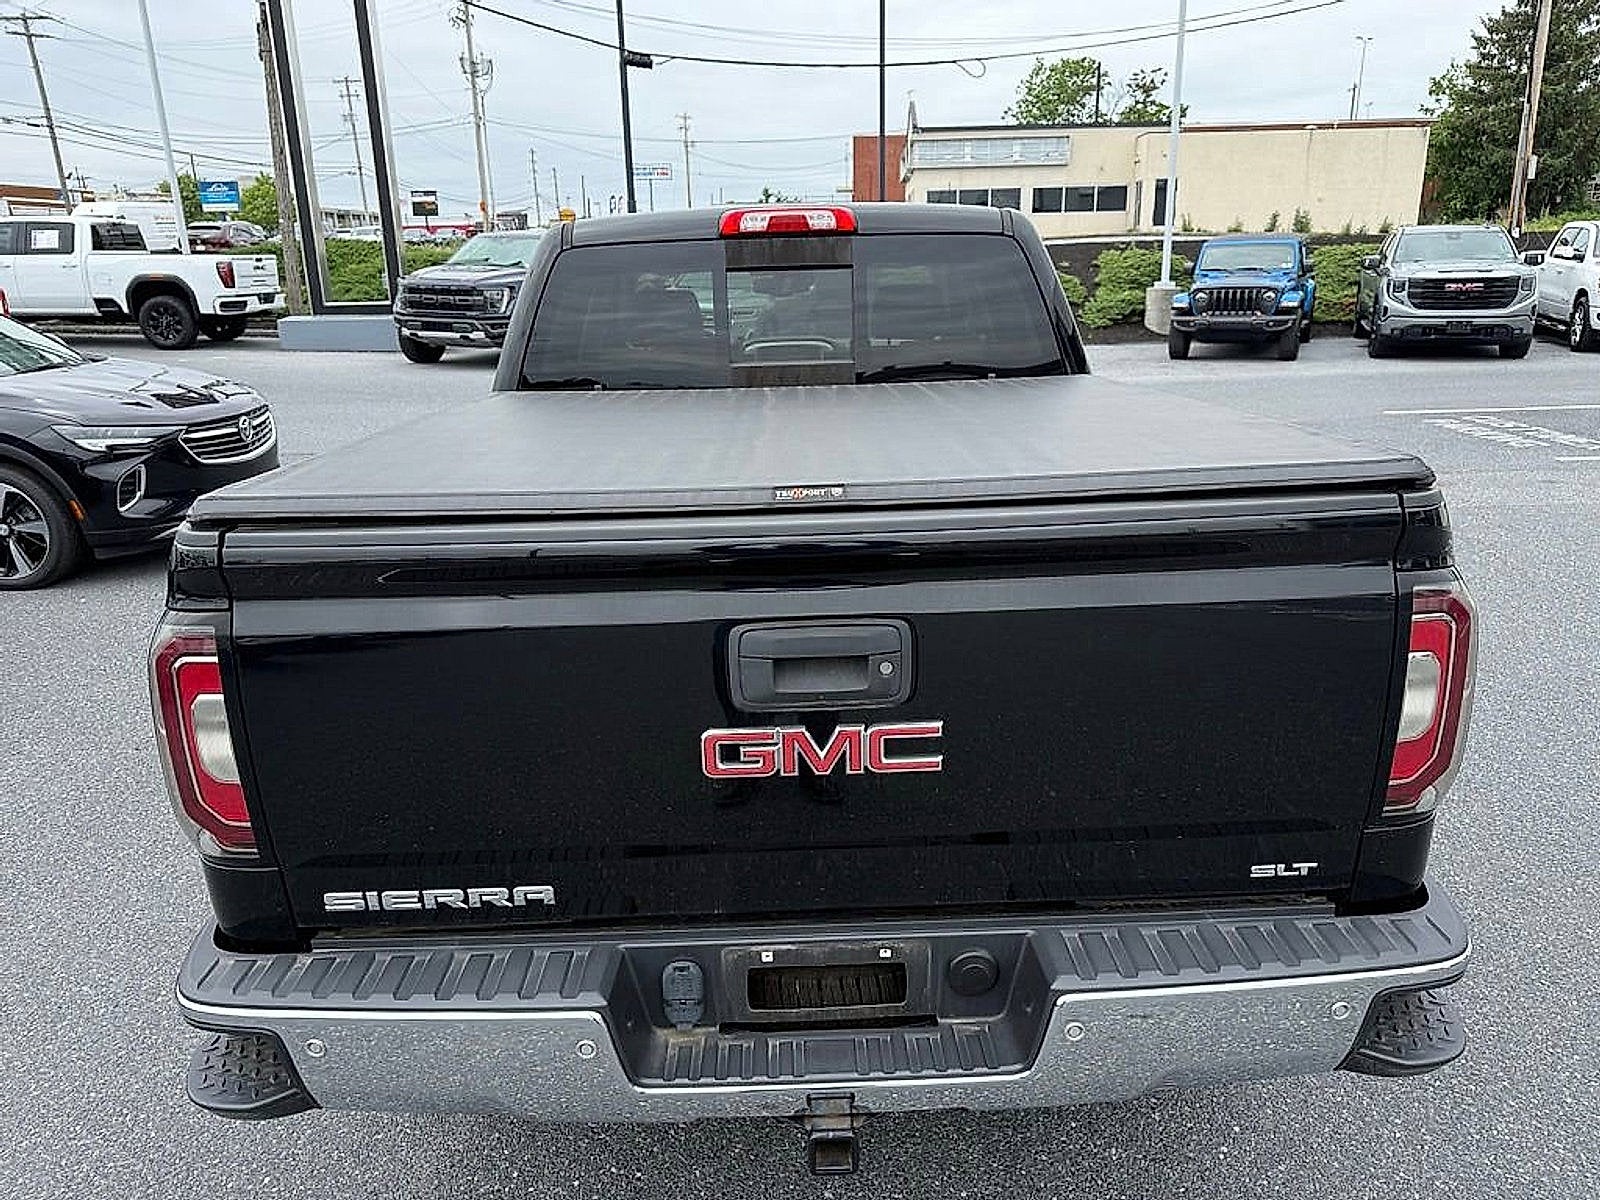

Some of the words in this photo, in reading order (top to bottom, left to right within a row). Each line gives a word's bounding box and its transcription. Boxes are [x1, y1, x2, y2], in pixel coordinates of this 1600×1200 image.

[701, 720, 943, 778] GMC
[1250, 863, 1318, 878] SLT
[323, 885, 556, 912] SIERRA
